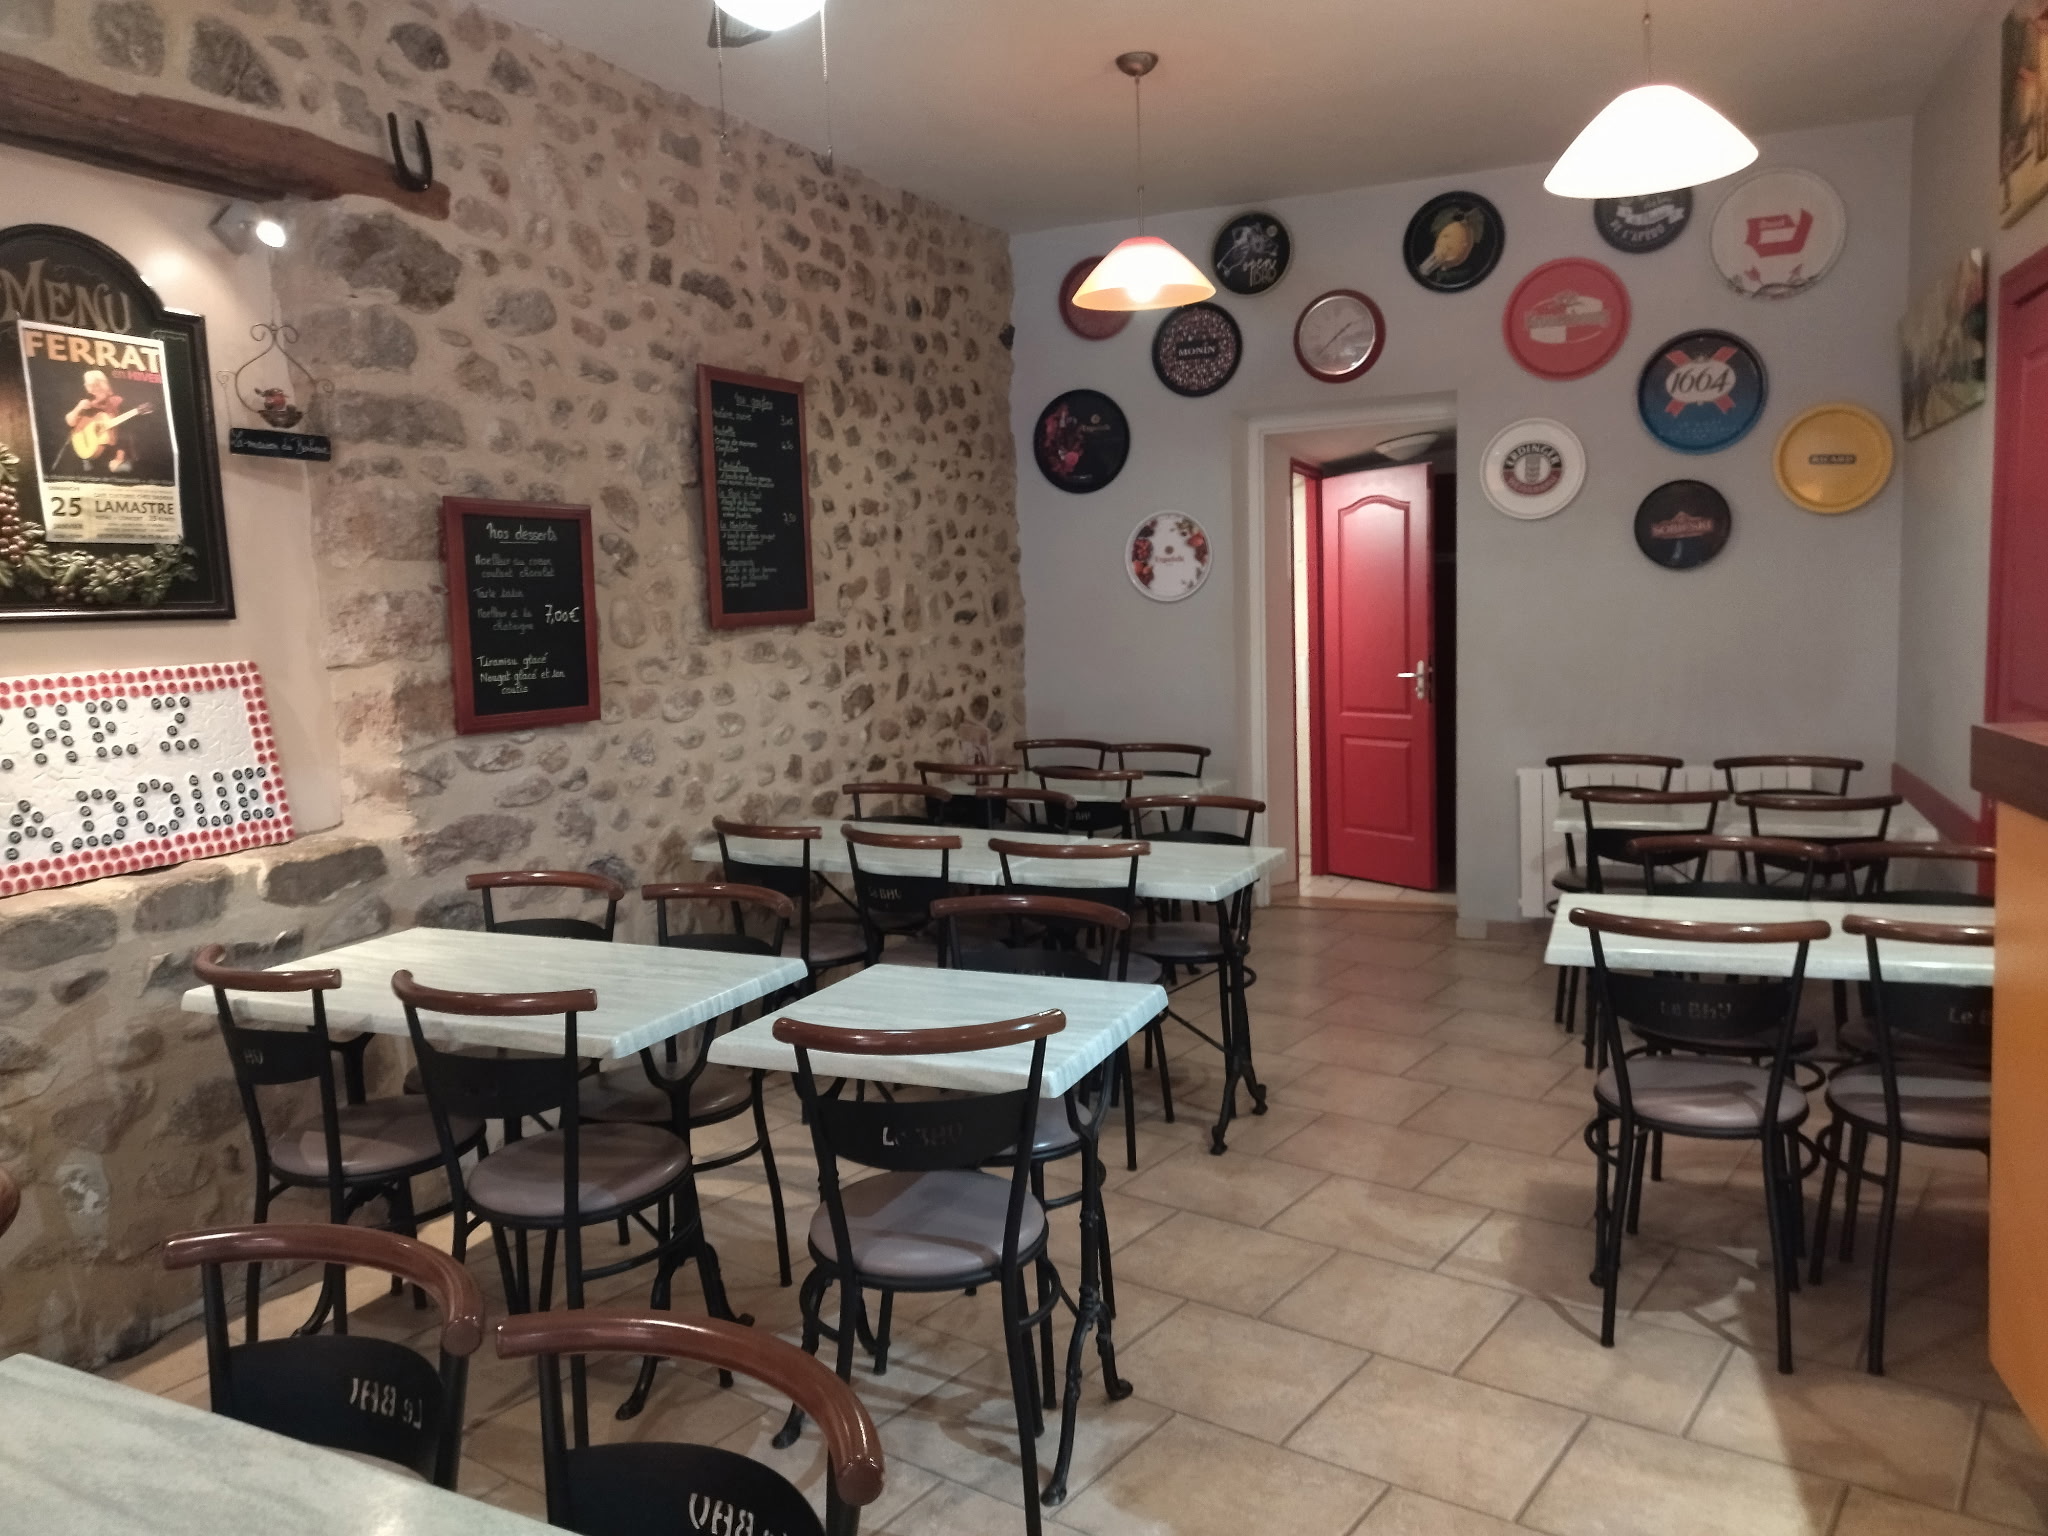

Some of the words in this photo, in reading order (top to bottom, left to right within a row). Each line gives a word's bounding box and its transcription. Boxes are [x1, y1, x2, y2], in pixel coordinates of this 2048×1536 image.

[0, 258, 132, 335] MENU
[24, 330, 161, 373] FERRAT
[1178, 345, 1216, 356] MONIN
[1671, 367, 1730, 394] 1664
[51, 497, 82, 517] 25
[95, 500, 176, 516] LAMASTRE
[514, 524, 558, 541] desserts
[544, 604, 580, 624] 7,00€
[523, 652, 548, 670] glacé
[480, 671, 511, 687] Nougat
[514, 669, 537, 686] glacé
[541, 667, 550, 679] et
